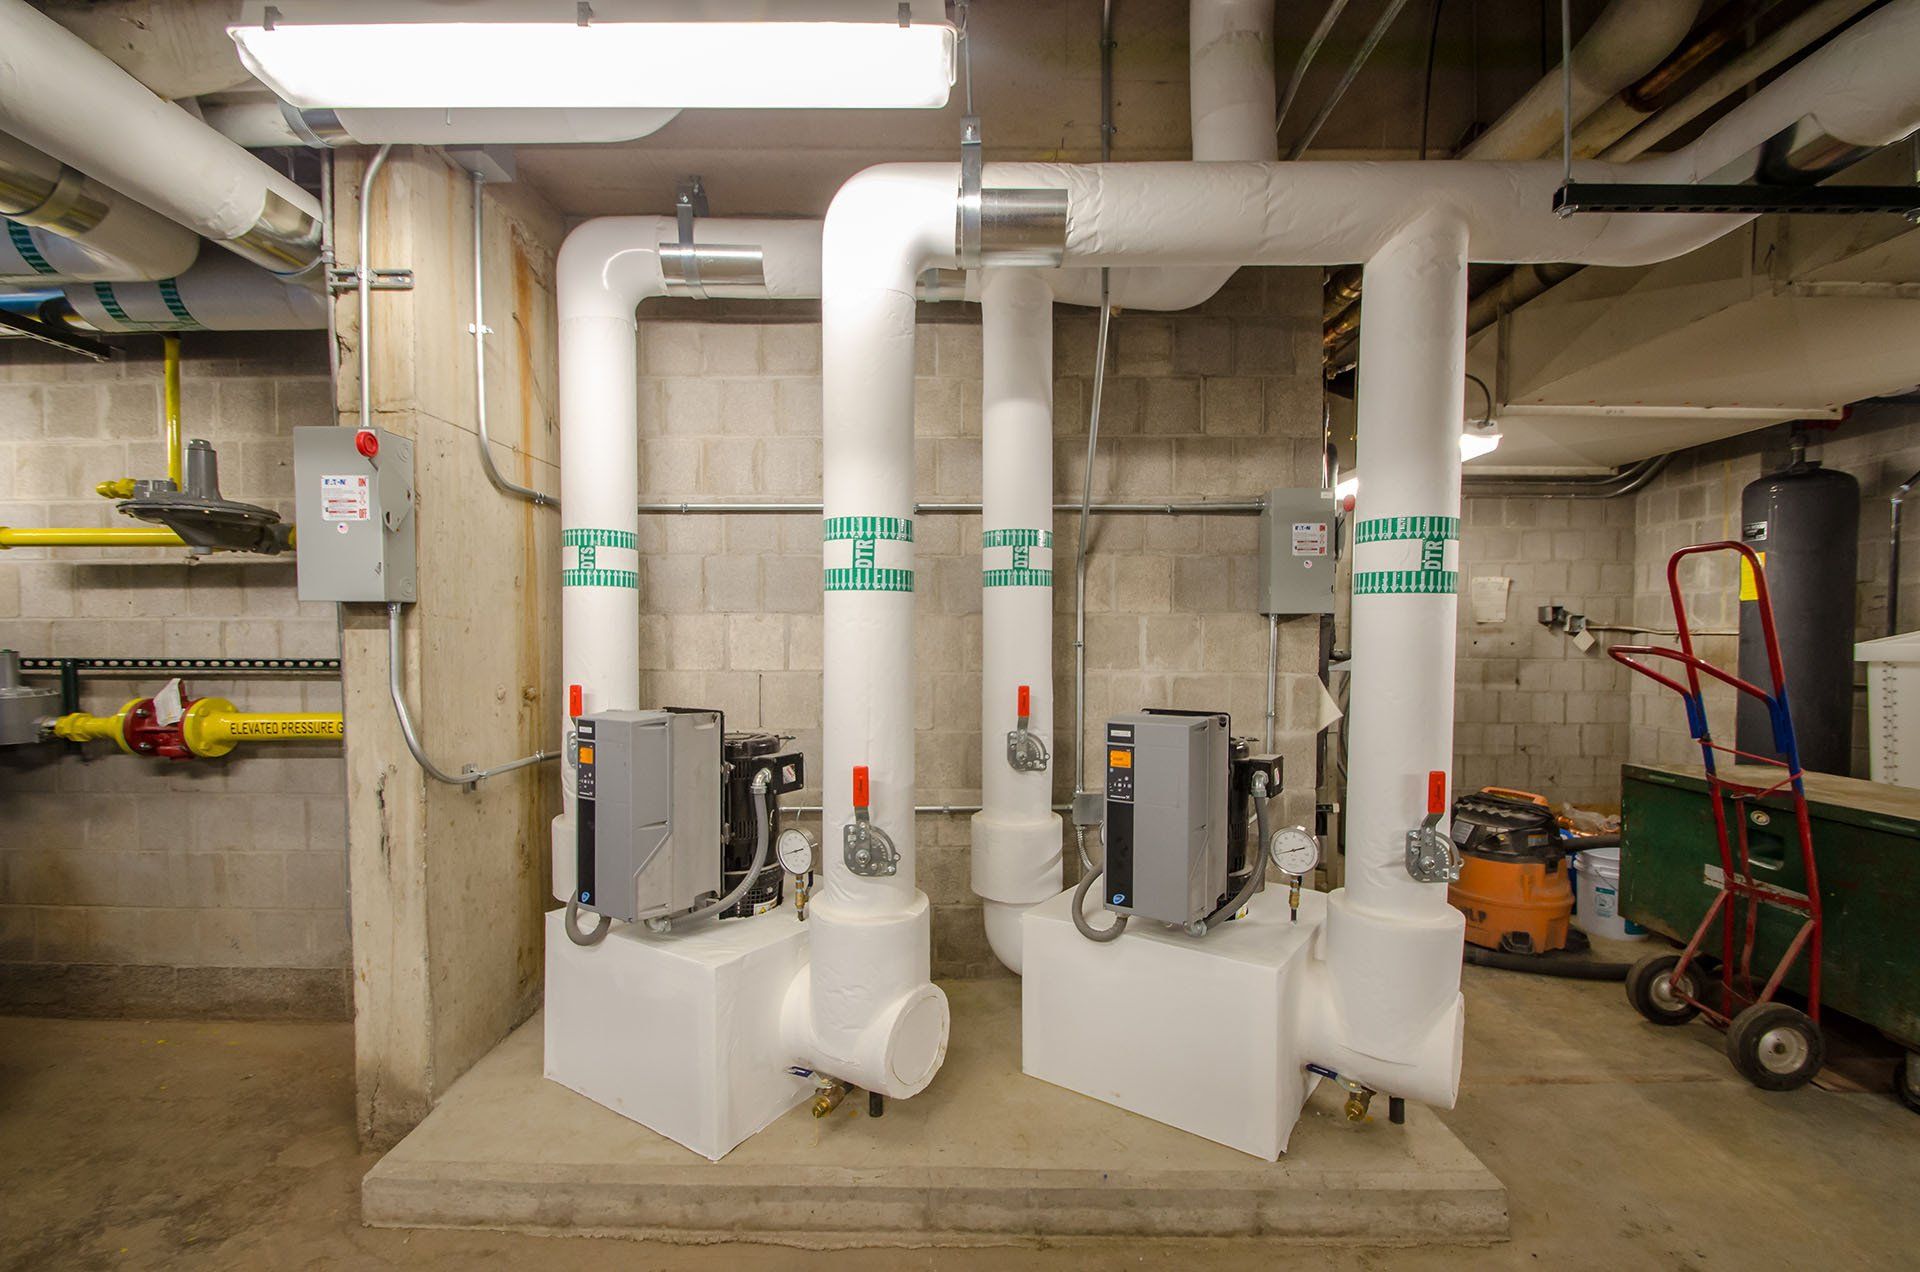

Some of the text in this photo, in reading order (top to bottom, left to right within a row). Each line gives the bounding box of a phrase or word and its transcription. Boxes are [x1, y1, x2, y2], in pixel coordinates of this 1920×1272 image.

[580, 546, 595, 569] DTS
[855, 539, 874, 568] DTR
[1014, 546, 1029, 568] DTS
[1424, 540, 1443, 570] DTR
[230, 722, 279, 735] ELEVATED
[281, 721, 334, 734] PRESSURE
